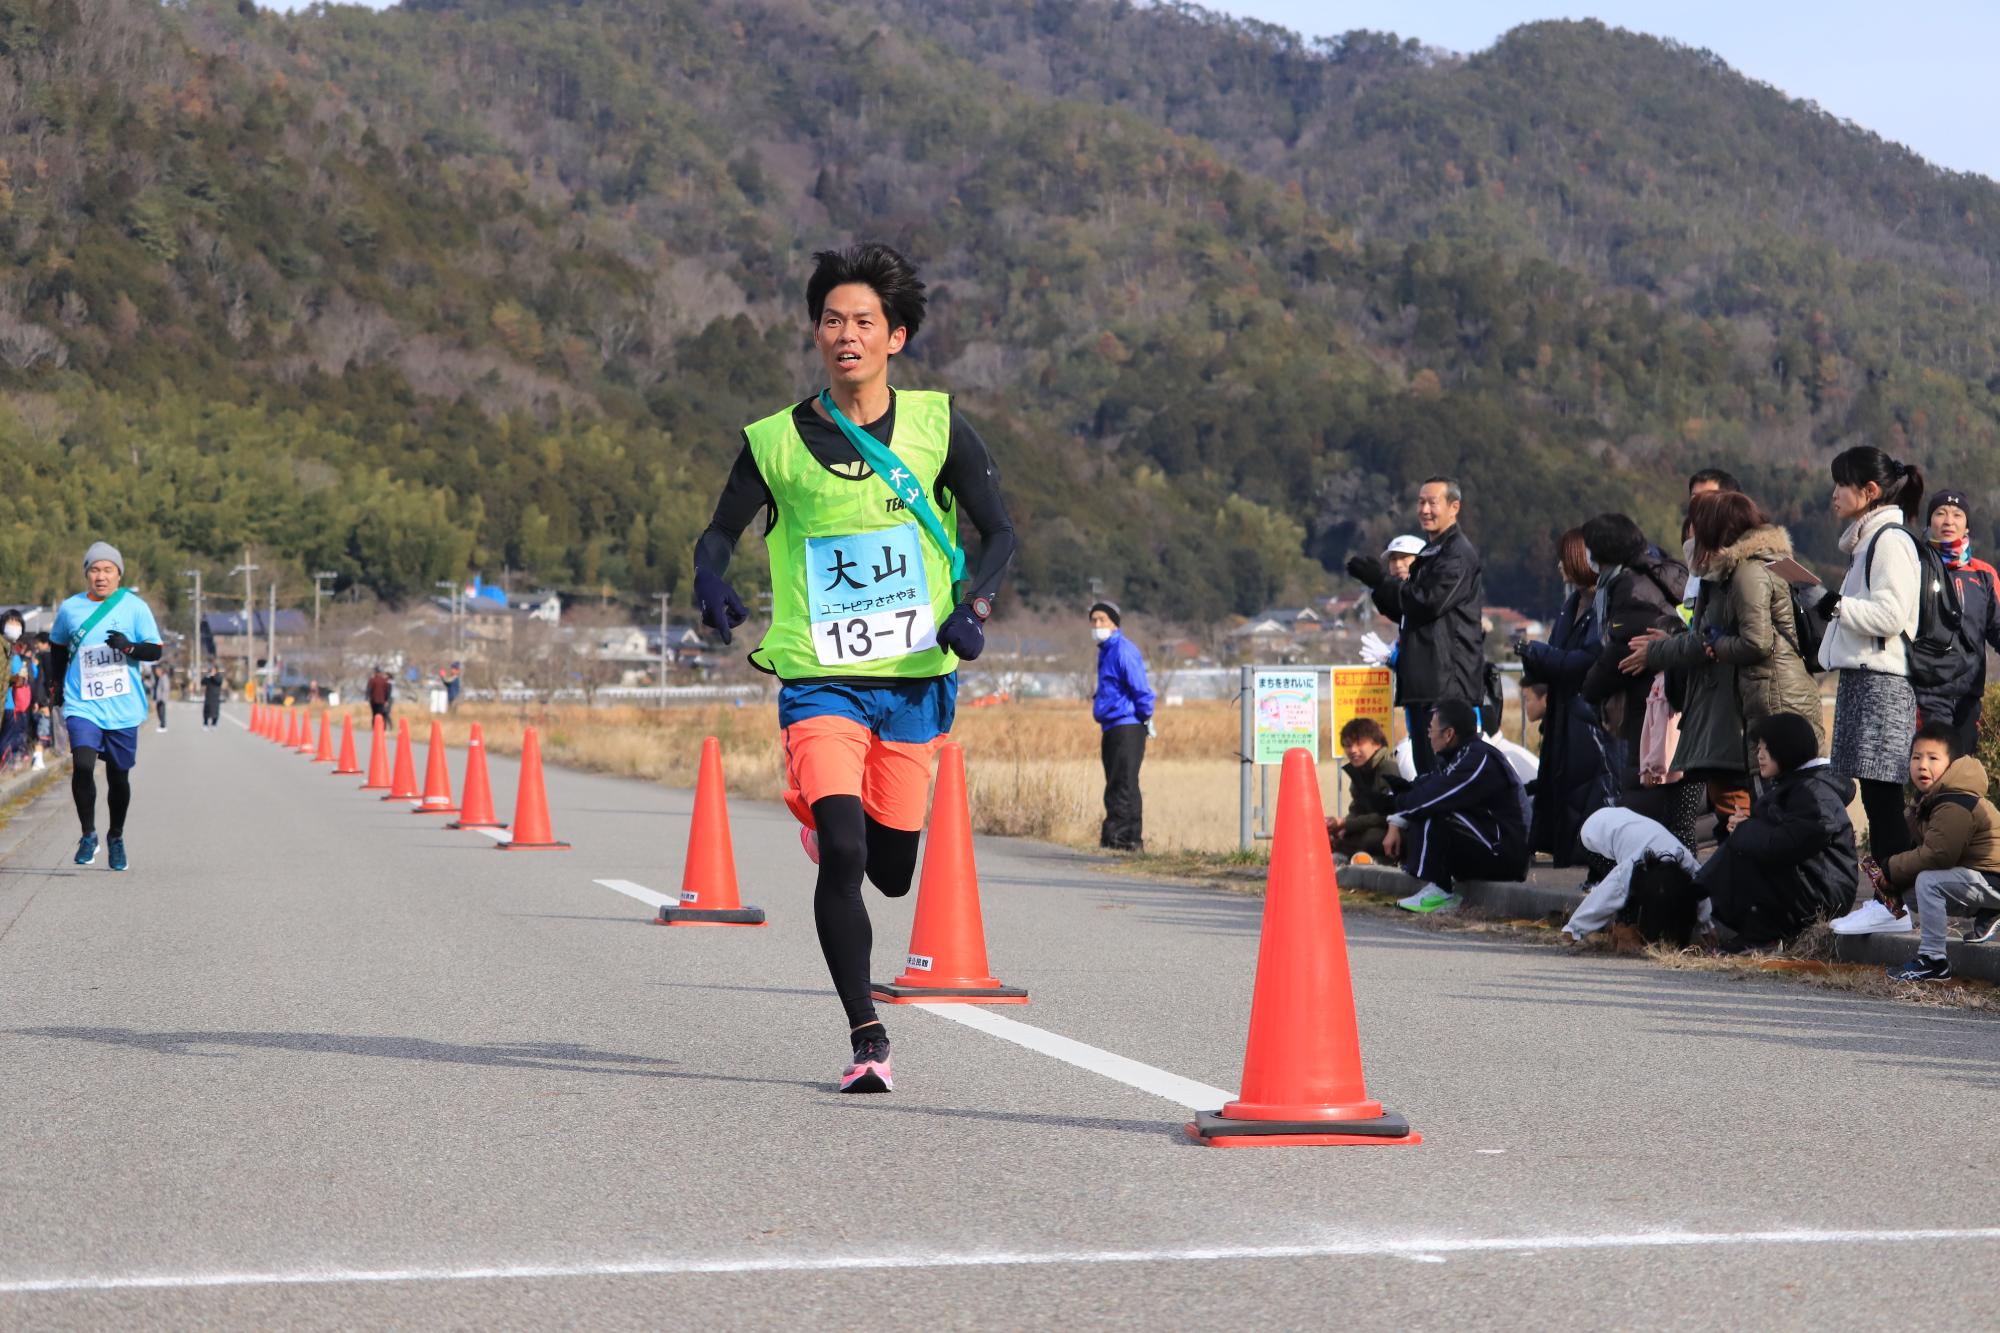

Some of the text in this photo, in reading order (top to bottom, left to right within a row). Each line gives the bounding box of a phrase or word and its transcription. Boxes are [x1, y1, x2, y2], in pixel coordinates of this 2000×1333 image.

[889, 467, 919, 505] 大山
[886, 497, 907, 512] TEA
[825, 546, 907, 592] 大山
[821, 588, 916, 615] ユニトピアささやま
[827, 610, 917, 660] 13-7
[87, 678, 123, 697] 18-6
[1259, 678, 1314, 689] まちをきれいに
